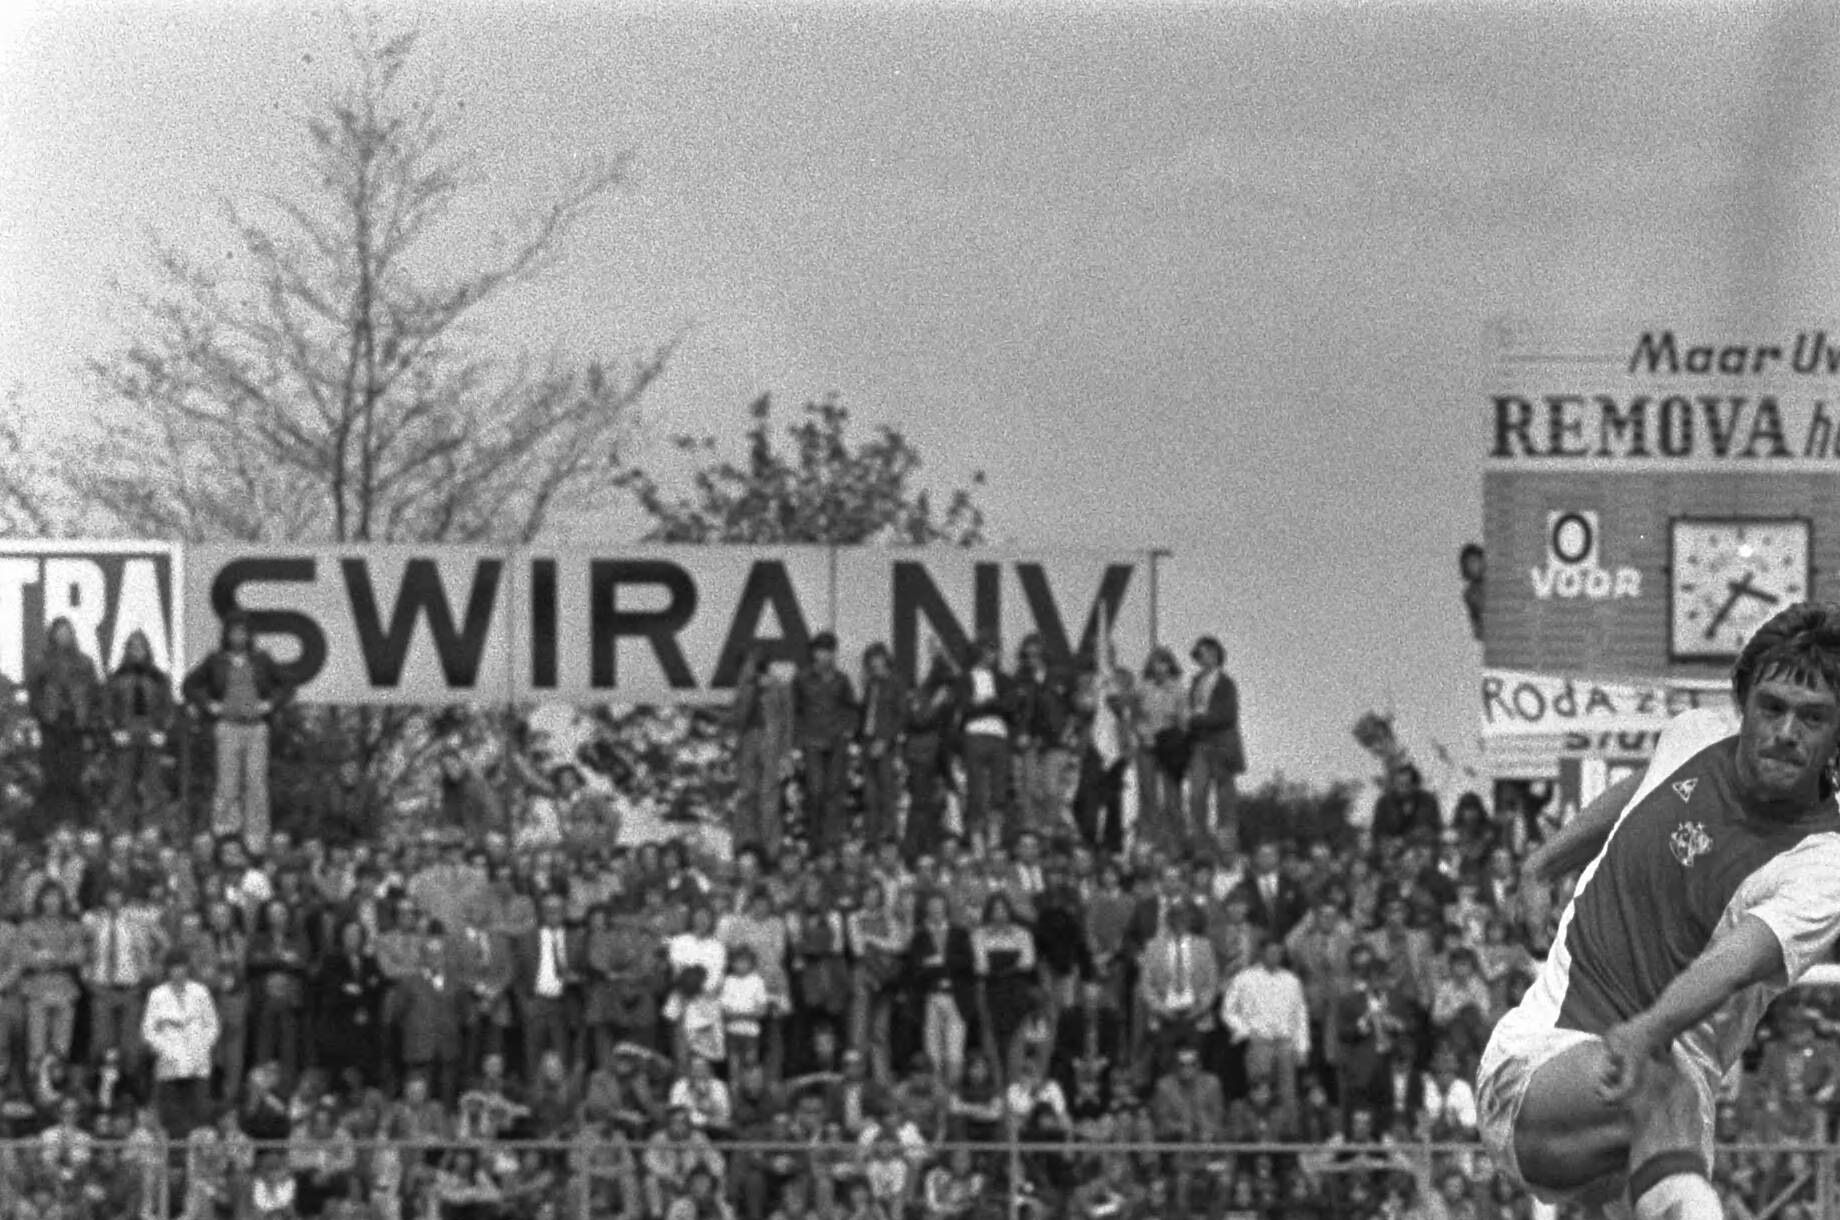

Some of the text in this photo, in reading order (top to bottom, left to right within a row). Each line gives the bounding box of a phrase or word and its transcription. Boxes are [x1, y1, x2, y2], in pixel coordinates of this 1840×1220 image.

[1628, 330, 1783, 375] Maar
[1489, 394, 1794, 459] REMOVA
[1529, 566, 1643, 601] VOOR
[210, 557, 812, 690] SWIRA
